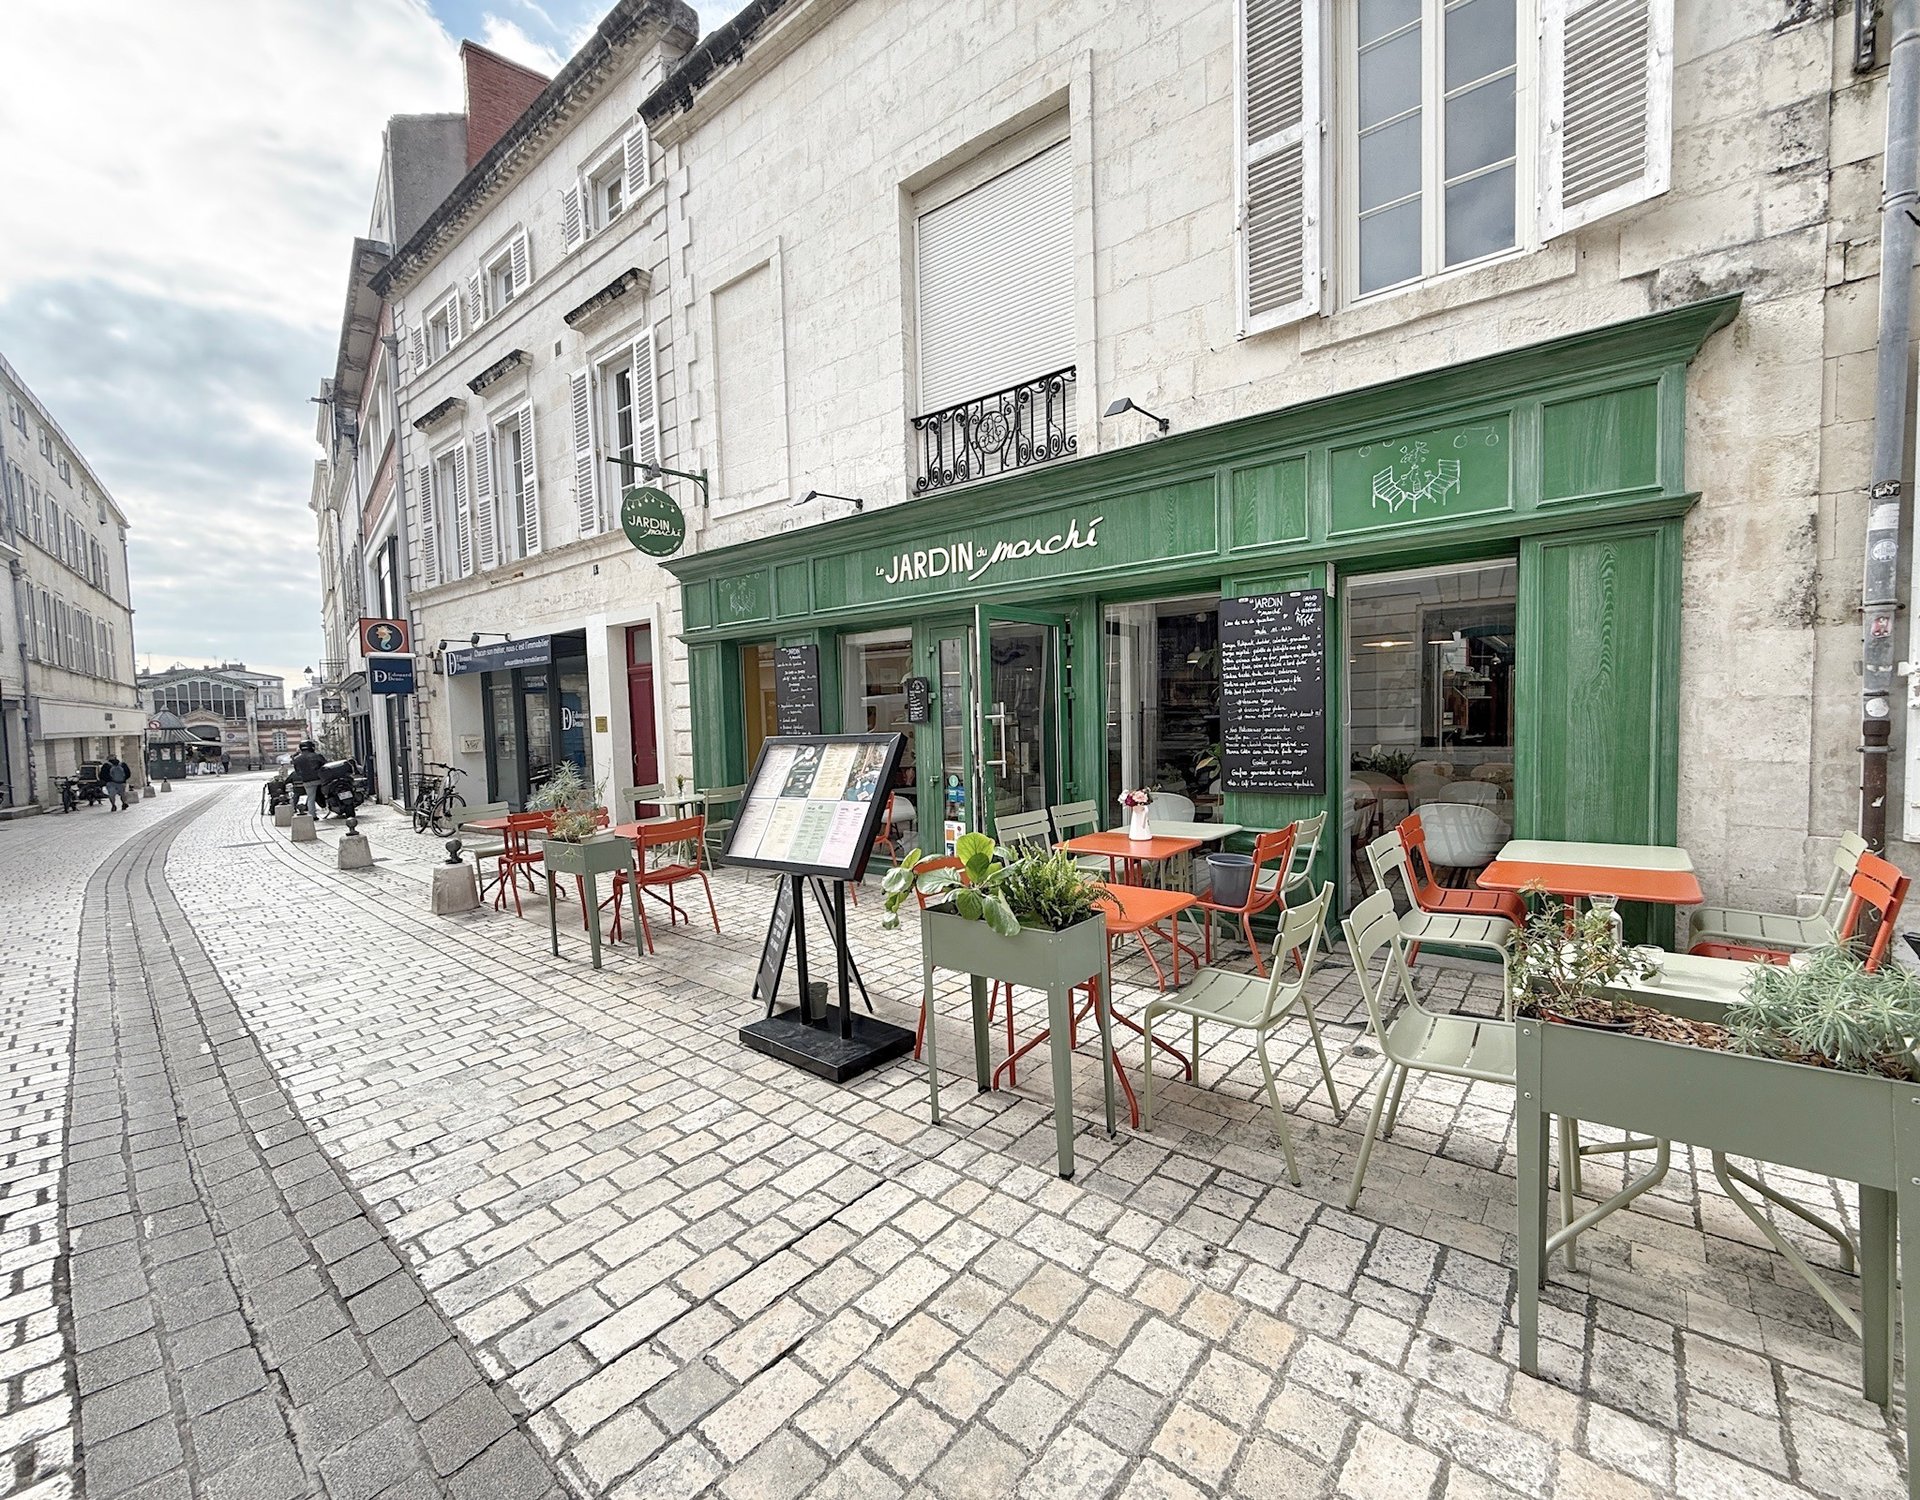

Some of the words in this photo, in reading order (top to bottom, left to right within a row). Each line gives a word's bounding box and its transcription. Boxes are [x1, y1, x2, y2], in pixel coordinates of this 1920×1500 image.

[628, 515, 670, 531] JARDIN
[968, 516, 1104, 582] marché
[976, 547, 988, 558] du
[885, 541, 974, 584] JARDIN
[876, 566, 884, 576] Le
[1252, 596, 1282, 610] JARDIN
